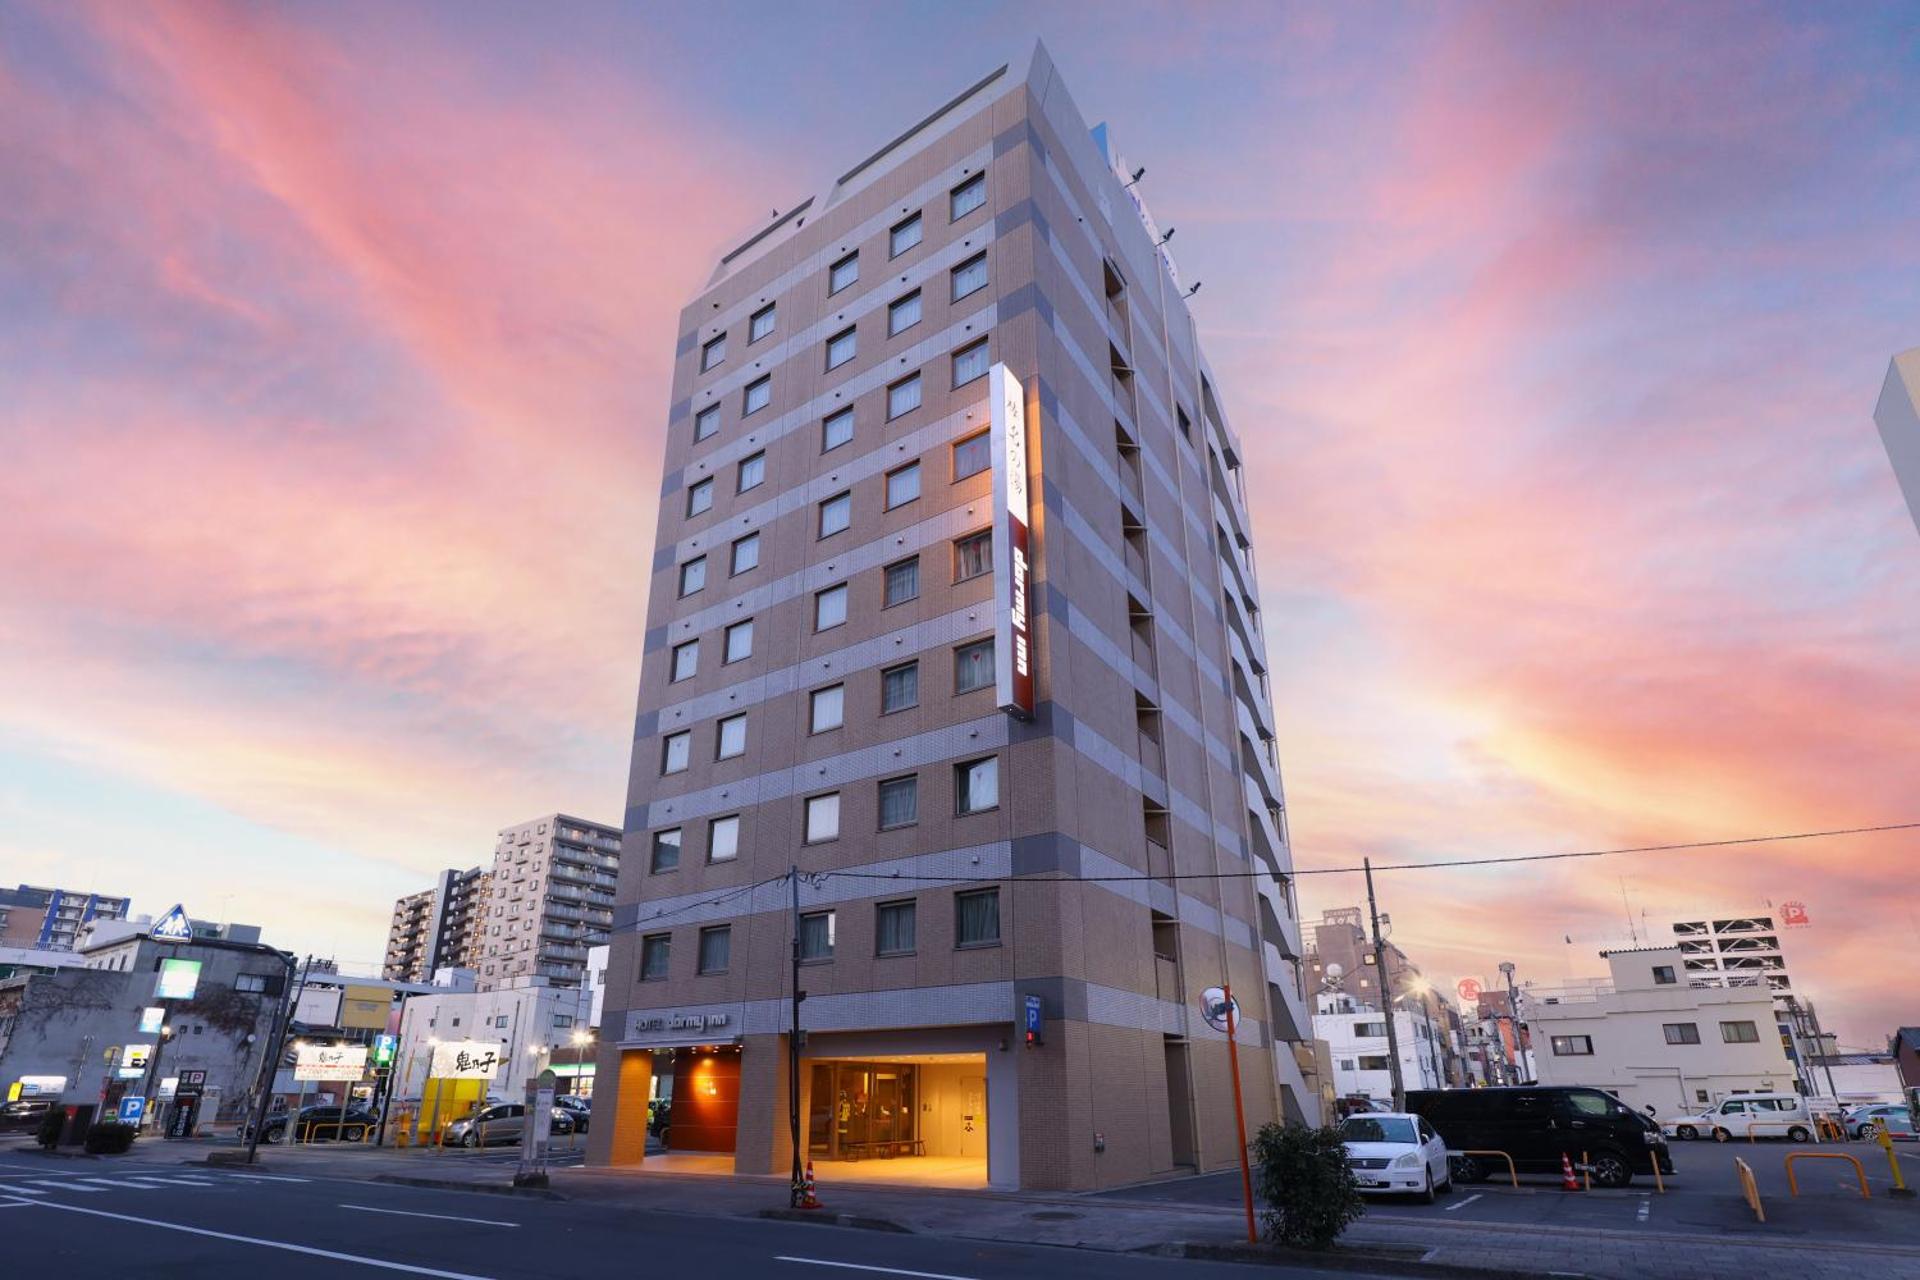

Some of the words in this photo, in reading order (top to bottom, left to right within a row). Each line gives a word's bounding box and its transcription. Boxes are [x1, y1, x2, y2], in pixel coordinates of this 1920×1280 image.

[1012, 546, 1028, 632] dormy
[1016, 634, 1028, 677] inn
[667, 1013, 705, 1032] dormy
[707, 1013, 727, 1026] inn
[1030, 1009, 1037, 1028] P
[126, 1101, 140, 1116] P
